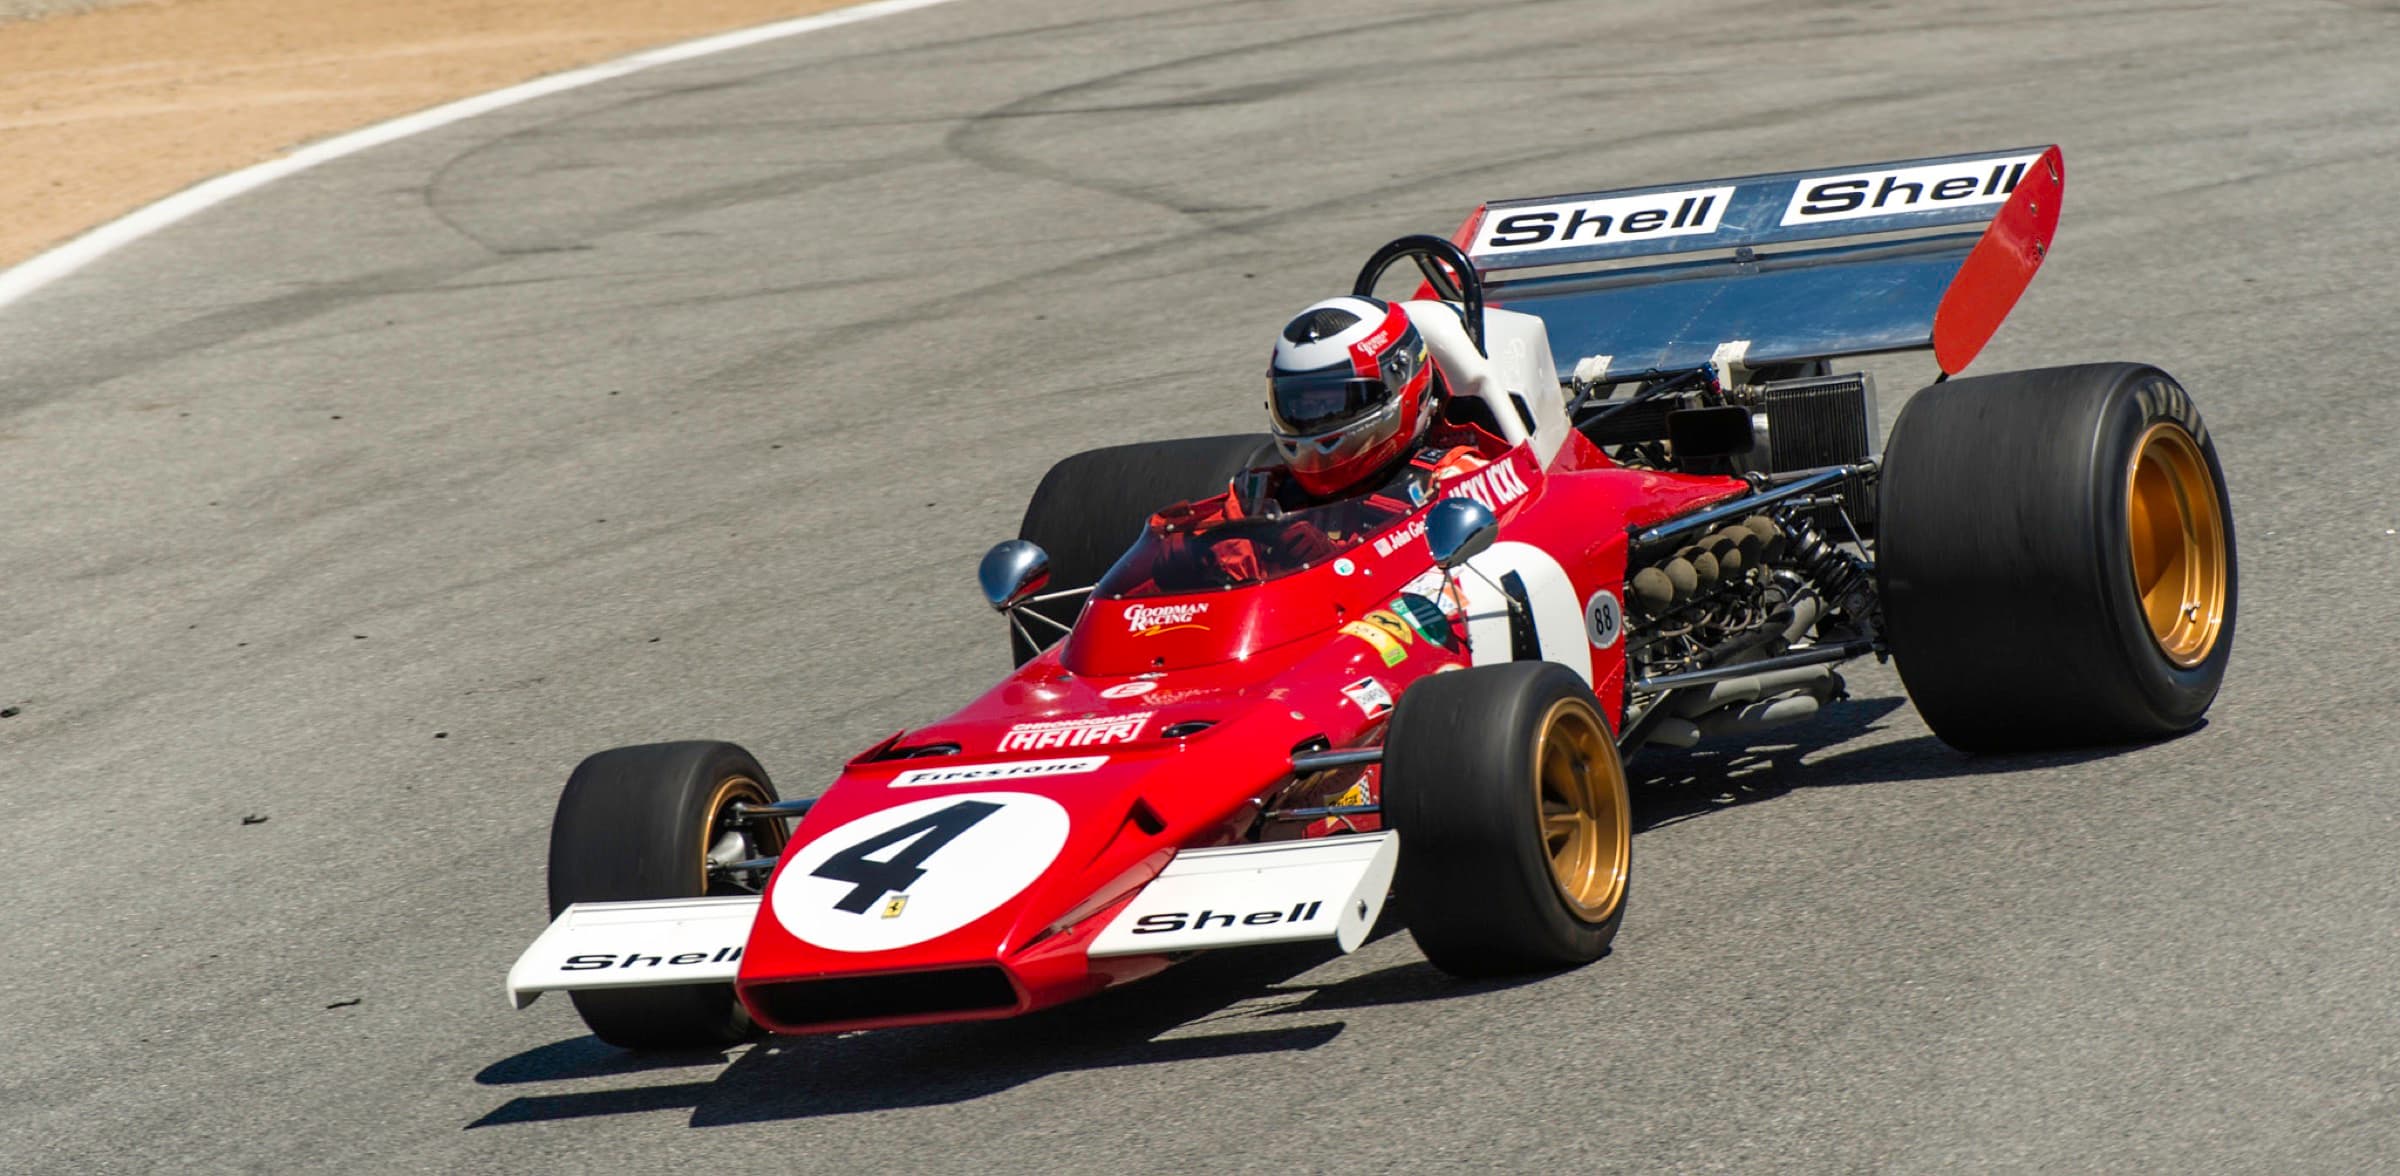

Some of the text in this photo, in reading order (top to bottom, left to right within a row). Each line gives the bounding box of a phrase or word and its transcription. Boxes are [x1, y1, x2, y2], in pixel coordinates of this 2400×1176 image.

[1800, 163, 2026, 216] Shell
[1489, 195, 1716, 248] Shell
[1123, 603, 1209, 621] GOODMAN
[1128, 613, 1193, 632] RACING
[1594, 604, 1613, 635] 88
[1011, 711, 1154, 731] CHRONOGRAPH
[909, 762, 1088, 784] Firestone
[809, 800, 1007, 915] 4
[1131, 901, 1323, 935] Shell
[560, 946, 744, 971] Shell
